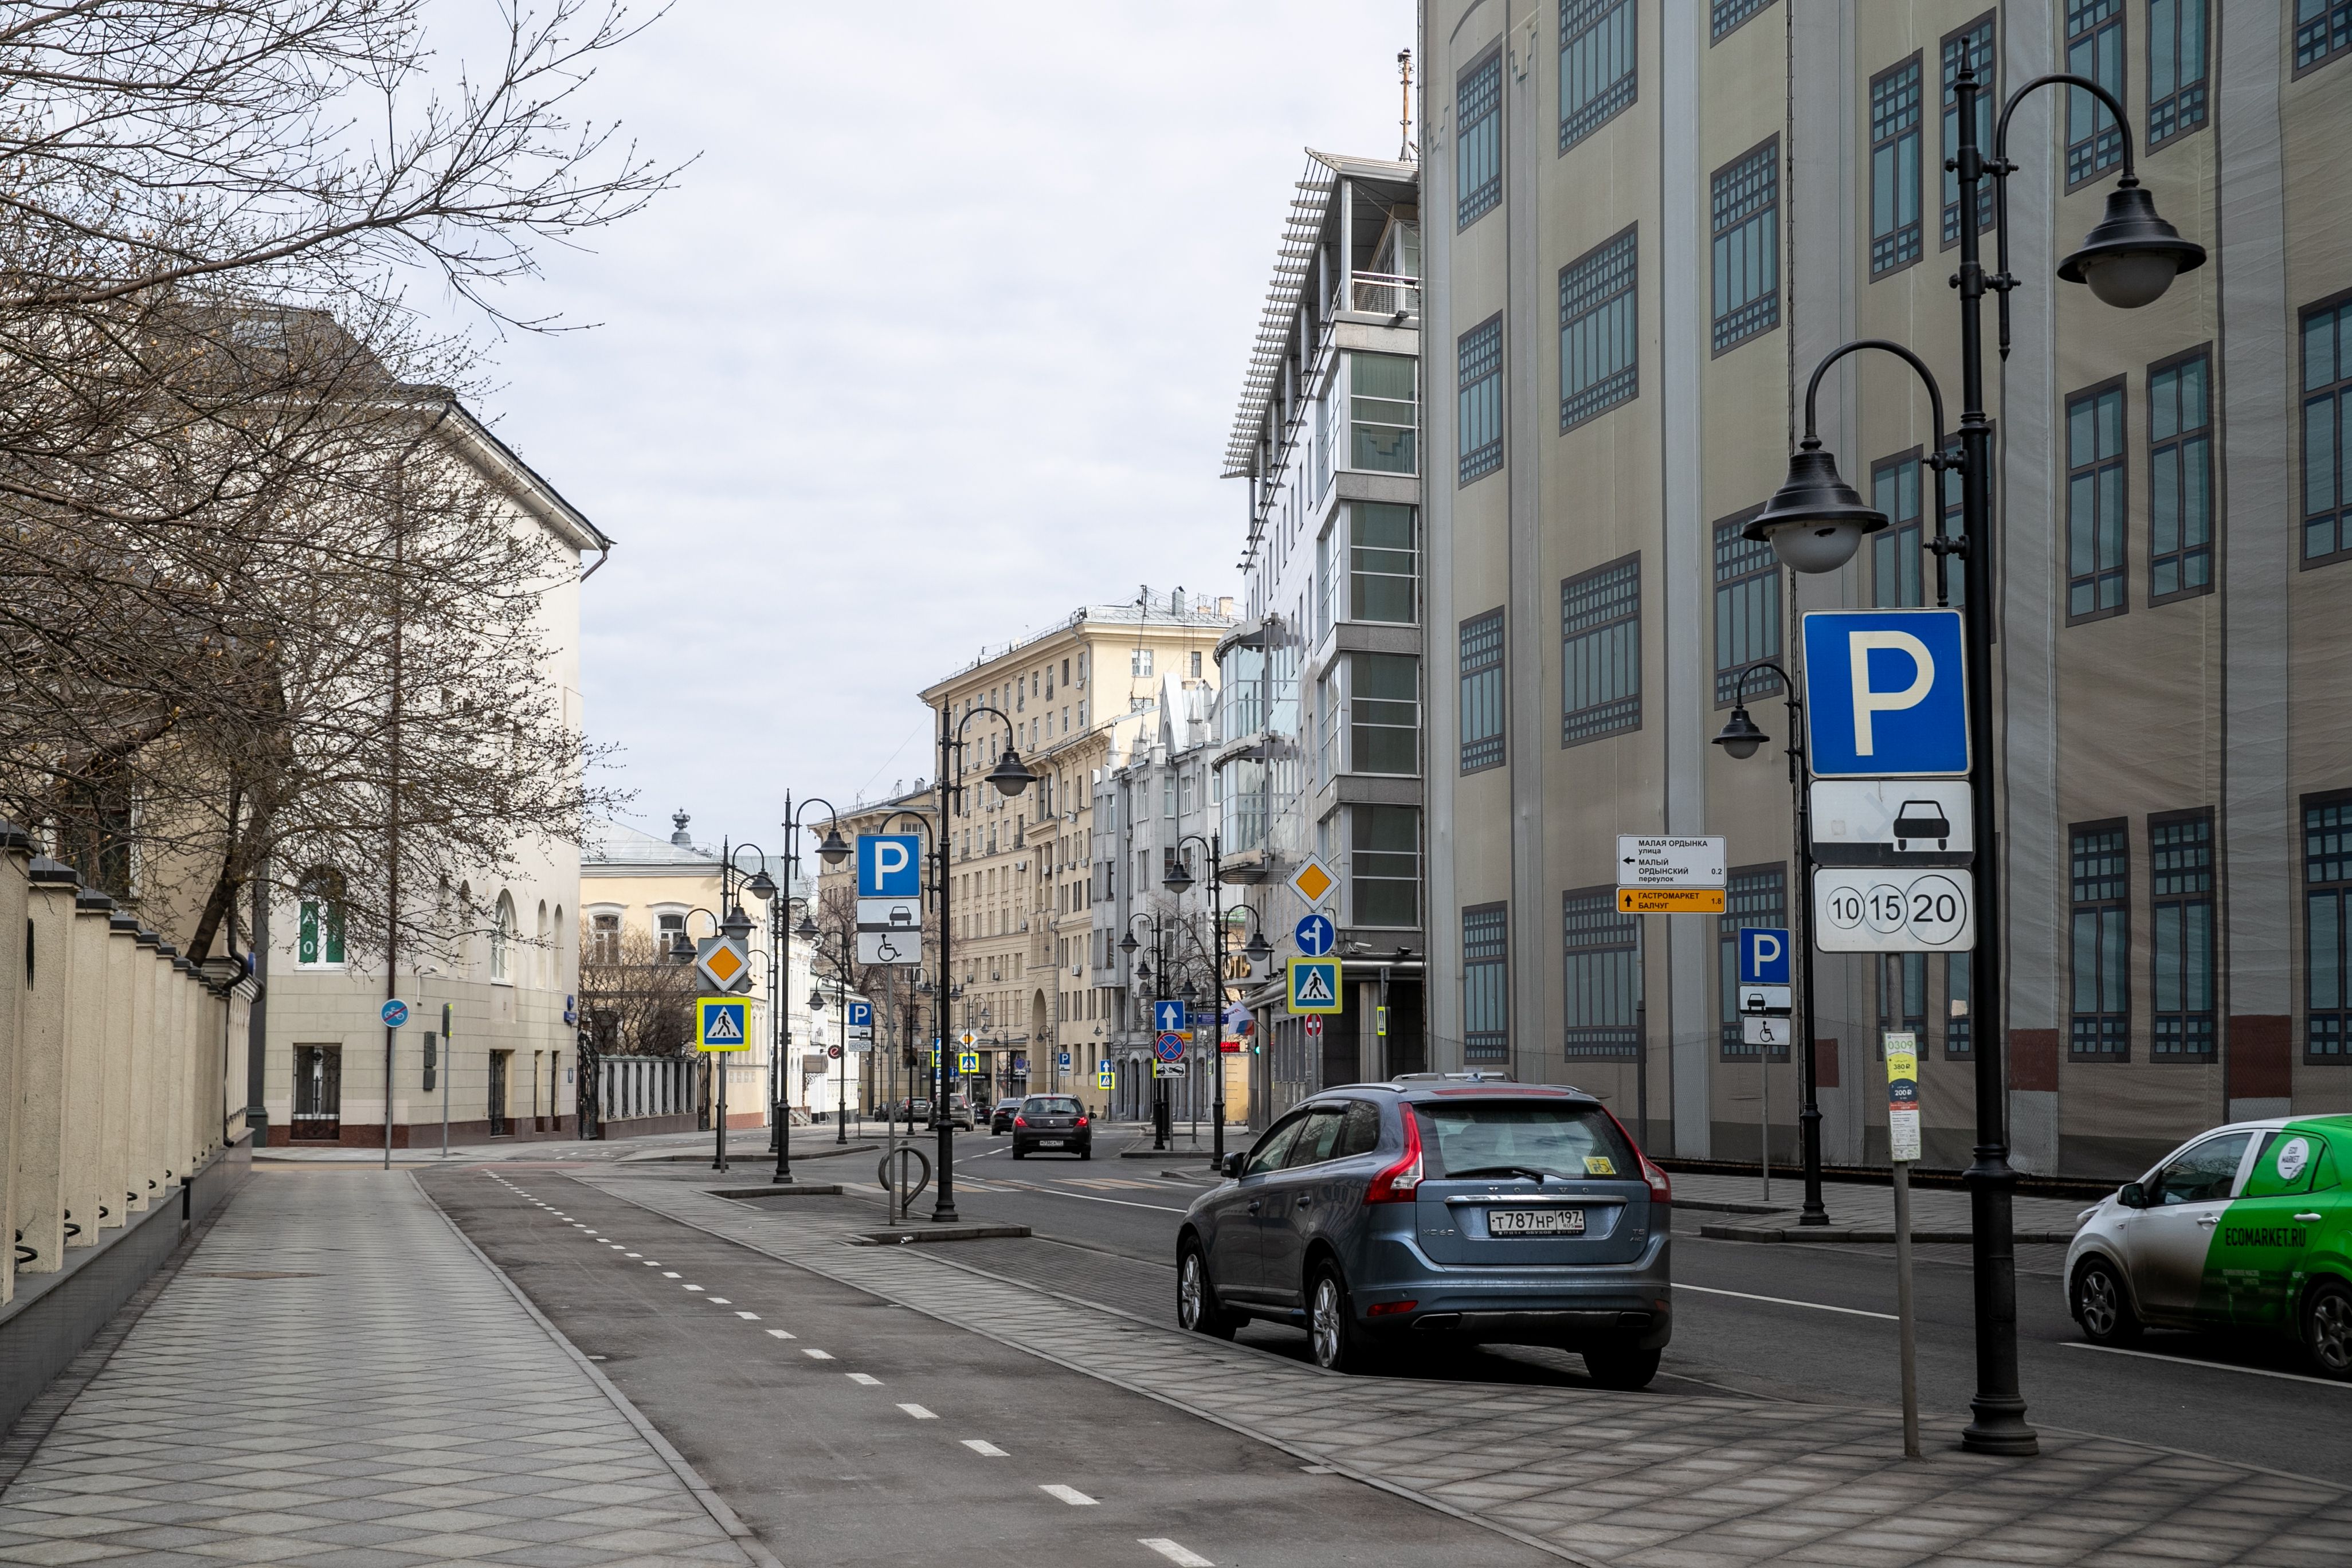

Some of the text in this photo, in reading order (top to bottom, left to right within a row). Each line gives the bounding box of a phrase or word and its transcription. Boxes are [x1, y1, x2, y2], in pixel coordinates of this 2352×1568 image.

[1849, 630, 1935, 756] P
[875, 841, 909, 890] P
[1638, 867, 1689, 876] ОРДЫНСКИЙ
[1832, 894, 1956, 923] 10 15 20
[1754, 934, 1781, 977] P
[855, 1005, 868, 1023] P
[1888, 1040, 1913, 1049] 0309
[1062, 1054, 1068, 1063] P
[1495, 1213, 1554, 1229] Т787НР
[1558, 1212, 1579, 1224] 197
[2225, 1228, 2306, 1247] ECOMARKET.RU
